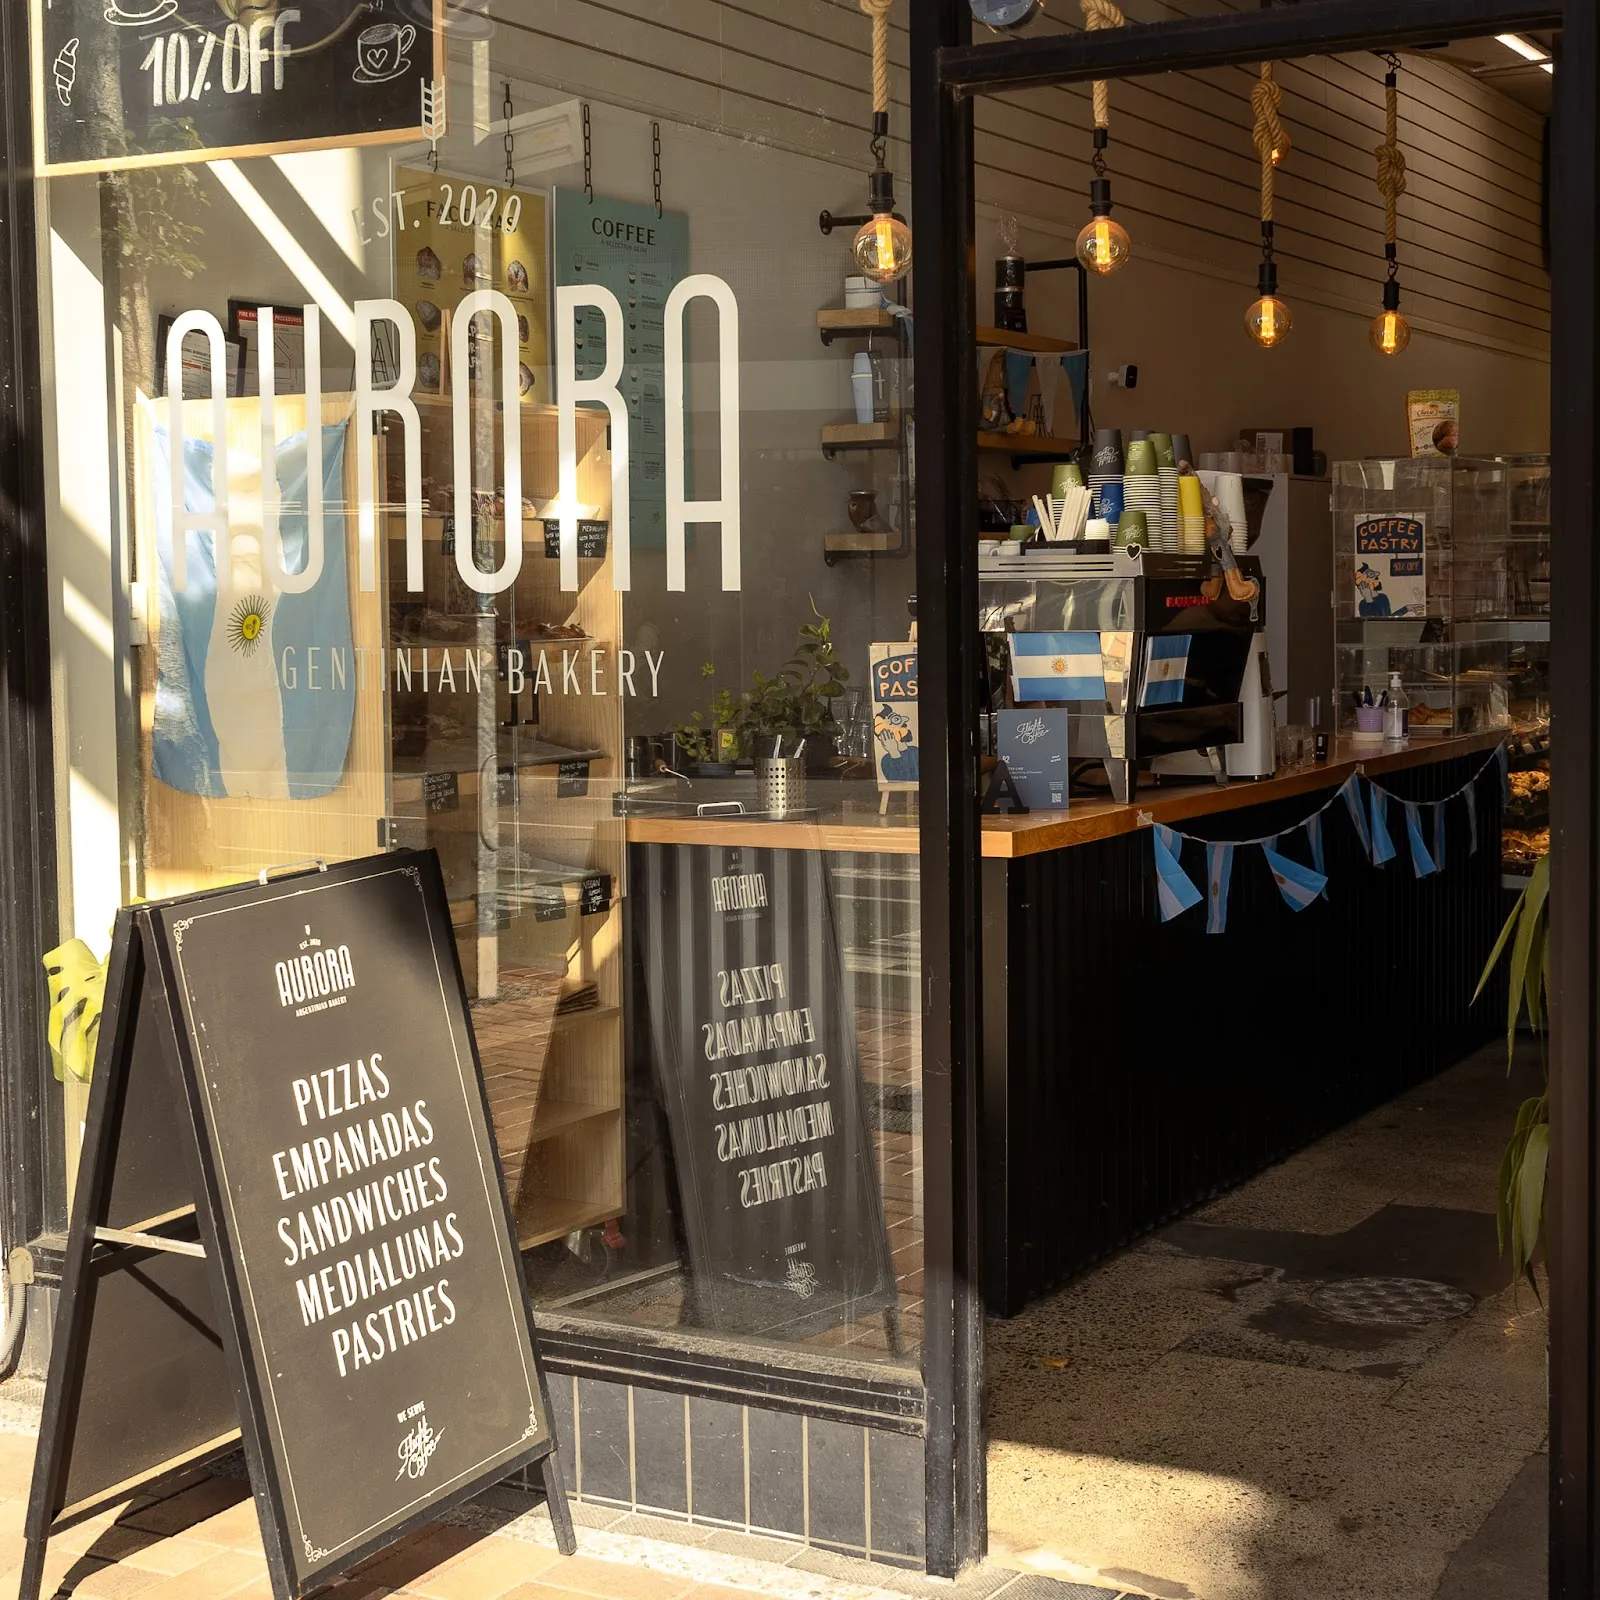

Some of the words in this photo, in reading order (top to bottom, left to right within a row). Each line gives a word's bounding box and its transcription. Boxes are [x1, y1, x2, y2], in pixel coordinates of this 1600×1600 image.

[139, 31, 214, 107] 10%
[222, 9, 301, 94] OFF
[351, 190, 421, 246] EST.
[439, 184, 522, 234] 2020
[591, 217, 656, 246] COFFEE
[165, 273, 741, 593] AURORA
[1360, 522, 1418, 537] COFFEE
[1360, 539, 1418, 551] PASTRY
[508, 649, 665, 697] BAKERY
[879, 680, 919, 698] PAS
[275, 944, 356, 1007] AURORA
[292, 1053, 390, 1126] PIZZAS
[272, 1099, 434, 1200] EMPANADAS
[277, 1156, 448, 1266] SANDWICHES
[296, 1212, 464, 1327] MEDIALUNAS
[332, 1279, 456, 1377] PASTRIES
